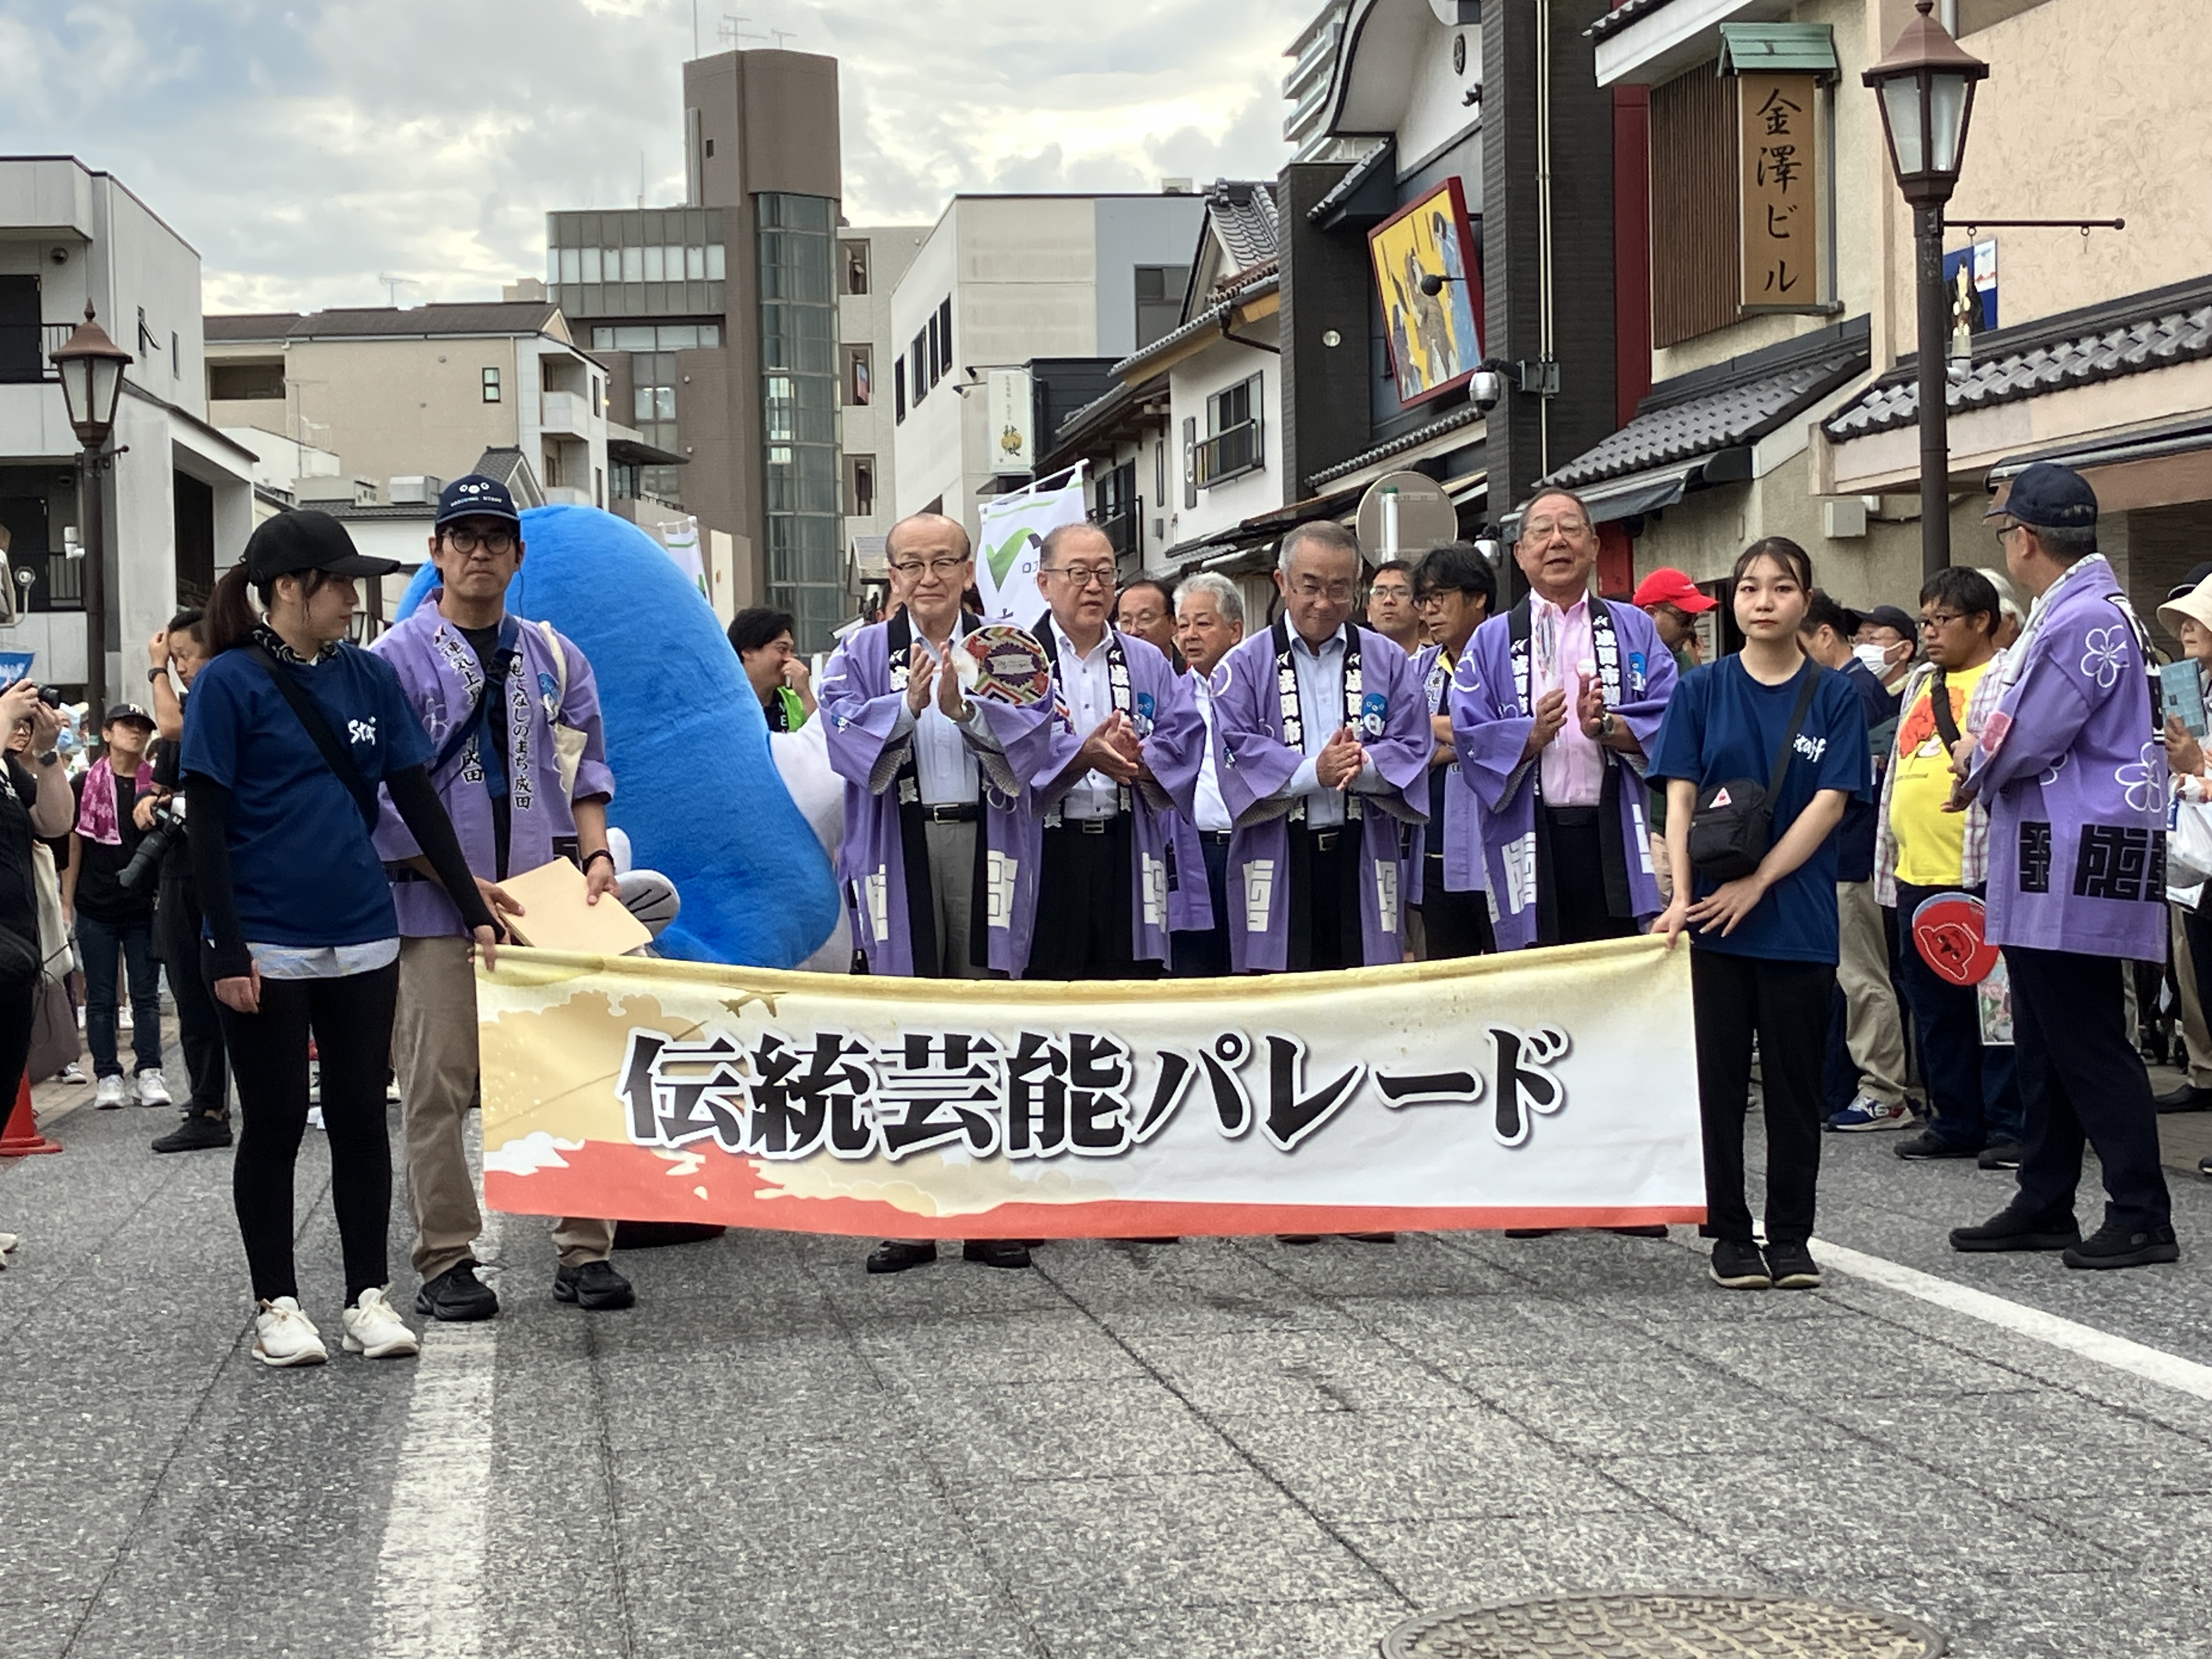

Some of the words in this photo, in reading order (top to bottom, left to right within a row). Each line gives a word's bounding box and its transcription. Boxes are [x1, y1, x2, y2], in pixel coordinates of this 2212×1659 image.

[1756, 88, 1803, 292] 金澤ビル
[620, 1027, 1565, 1158] 伝統芸能パレード
